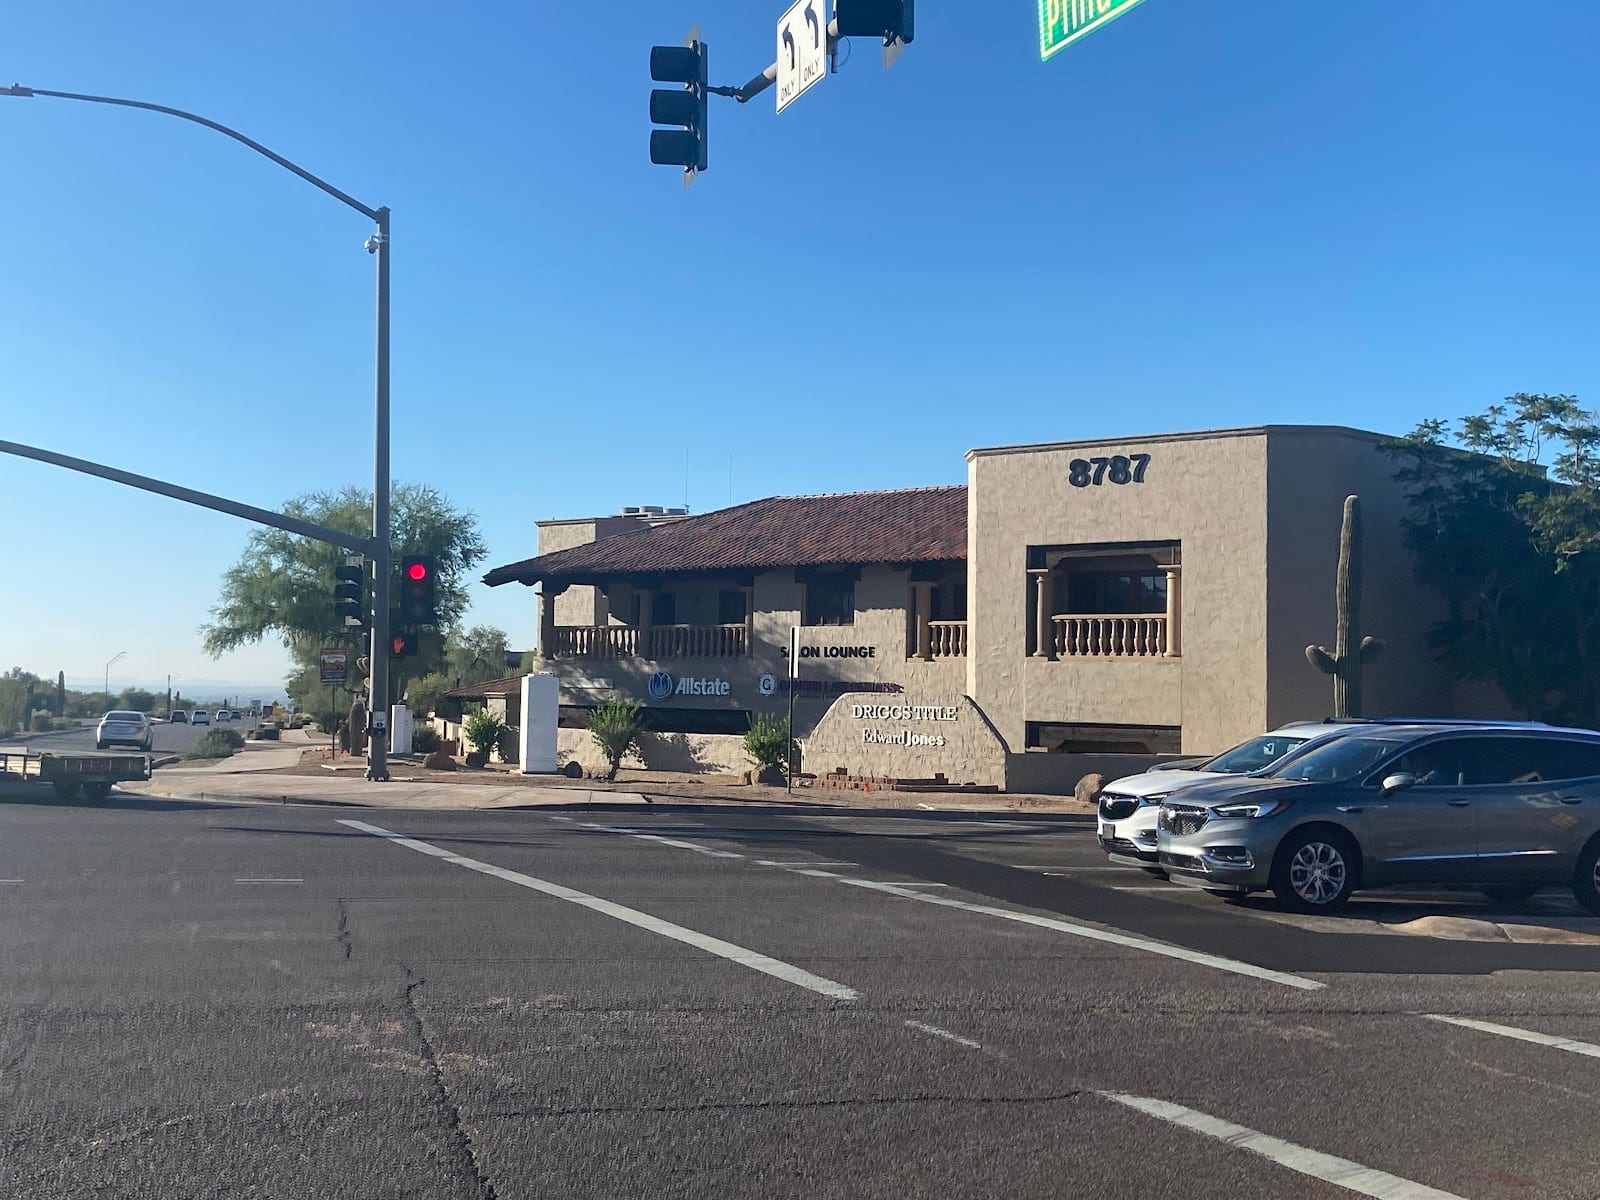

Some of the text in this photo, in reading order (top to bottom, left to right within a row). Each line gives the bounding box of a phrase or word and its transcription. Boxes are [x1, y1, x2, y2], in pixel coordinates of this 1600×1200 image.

[803, 58, 820, 82] ONLY
[780, 79, 795, 101] ONLY
[1068, 453, 1152, 487] 8787
[823, 646, 876, 658] LOUNGE
[674, 677, 731, 695] Allstate
[851, 704, 958, 721] DRIGGS TITLE
